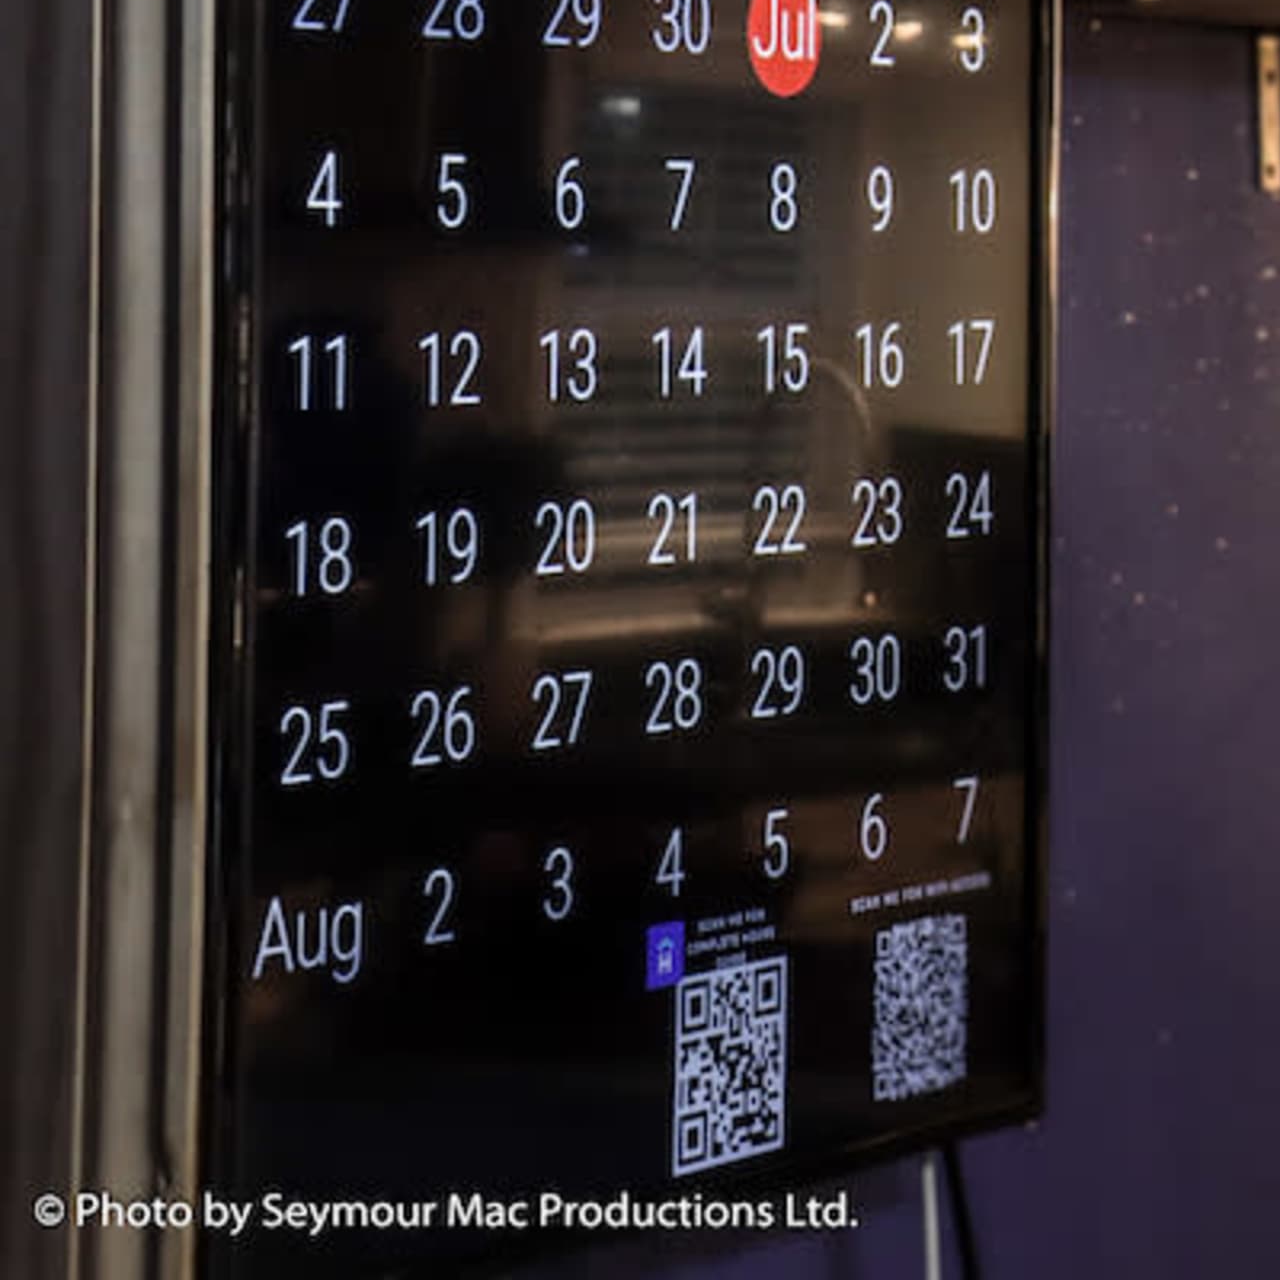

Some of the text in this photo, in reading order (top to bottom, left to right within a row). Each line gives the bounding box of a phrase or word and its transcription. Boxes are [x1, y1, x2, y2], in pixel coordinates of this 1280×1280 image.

[870, 0, 894, 65] 2
[961, 8, 984, 71] 3
[306, 151, 995, 233] 4 5 6 7 8 9 10
[289, 319, 994, 411] 11 12 13 14 15 16 17
[286, 473, 993, 596] 18 19 20 21 22 23 24
[280, 625, 985, 785] 25 26 27 28 29 30 31
[253, 777, 978, 983] Aug 2 3 4 5 6 7
